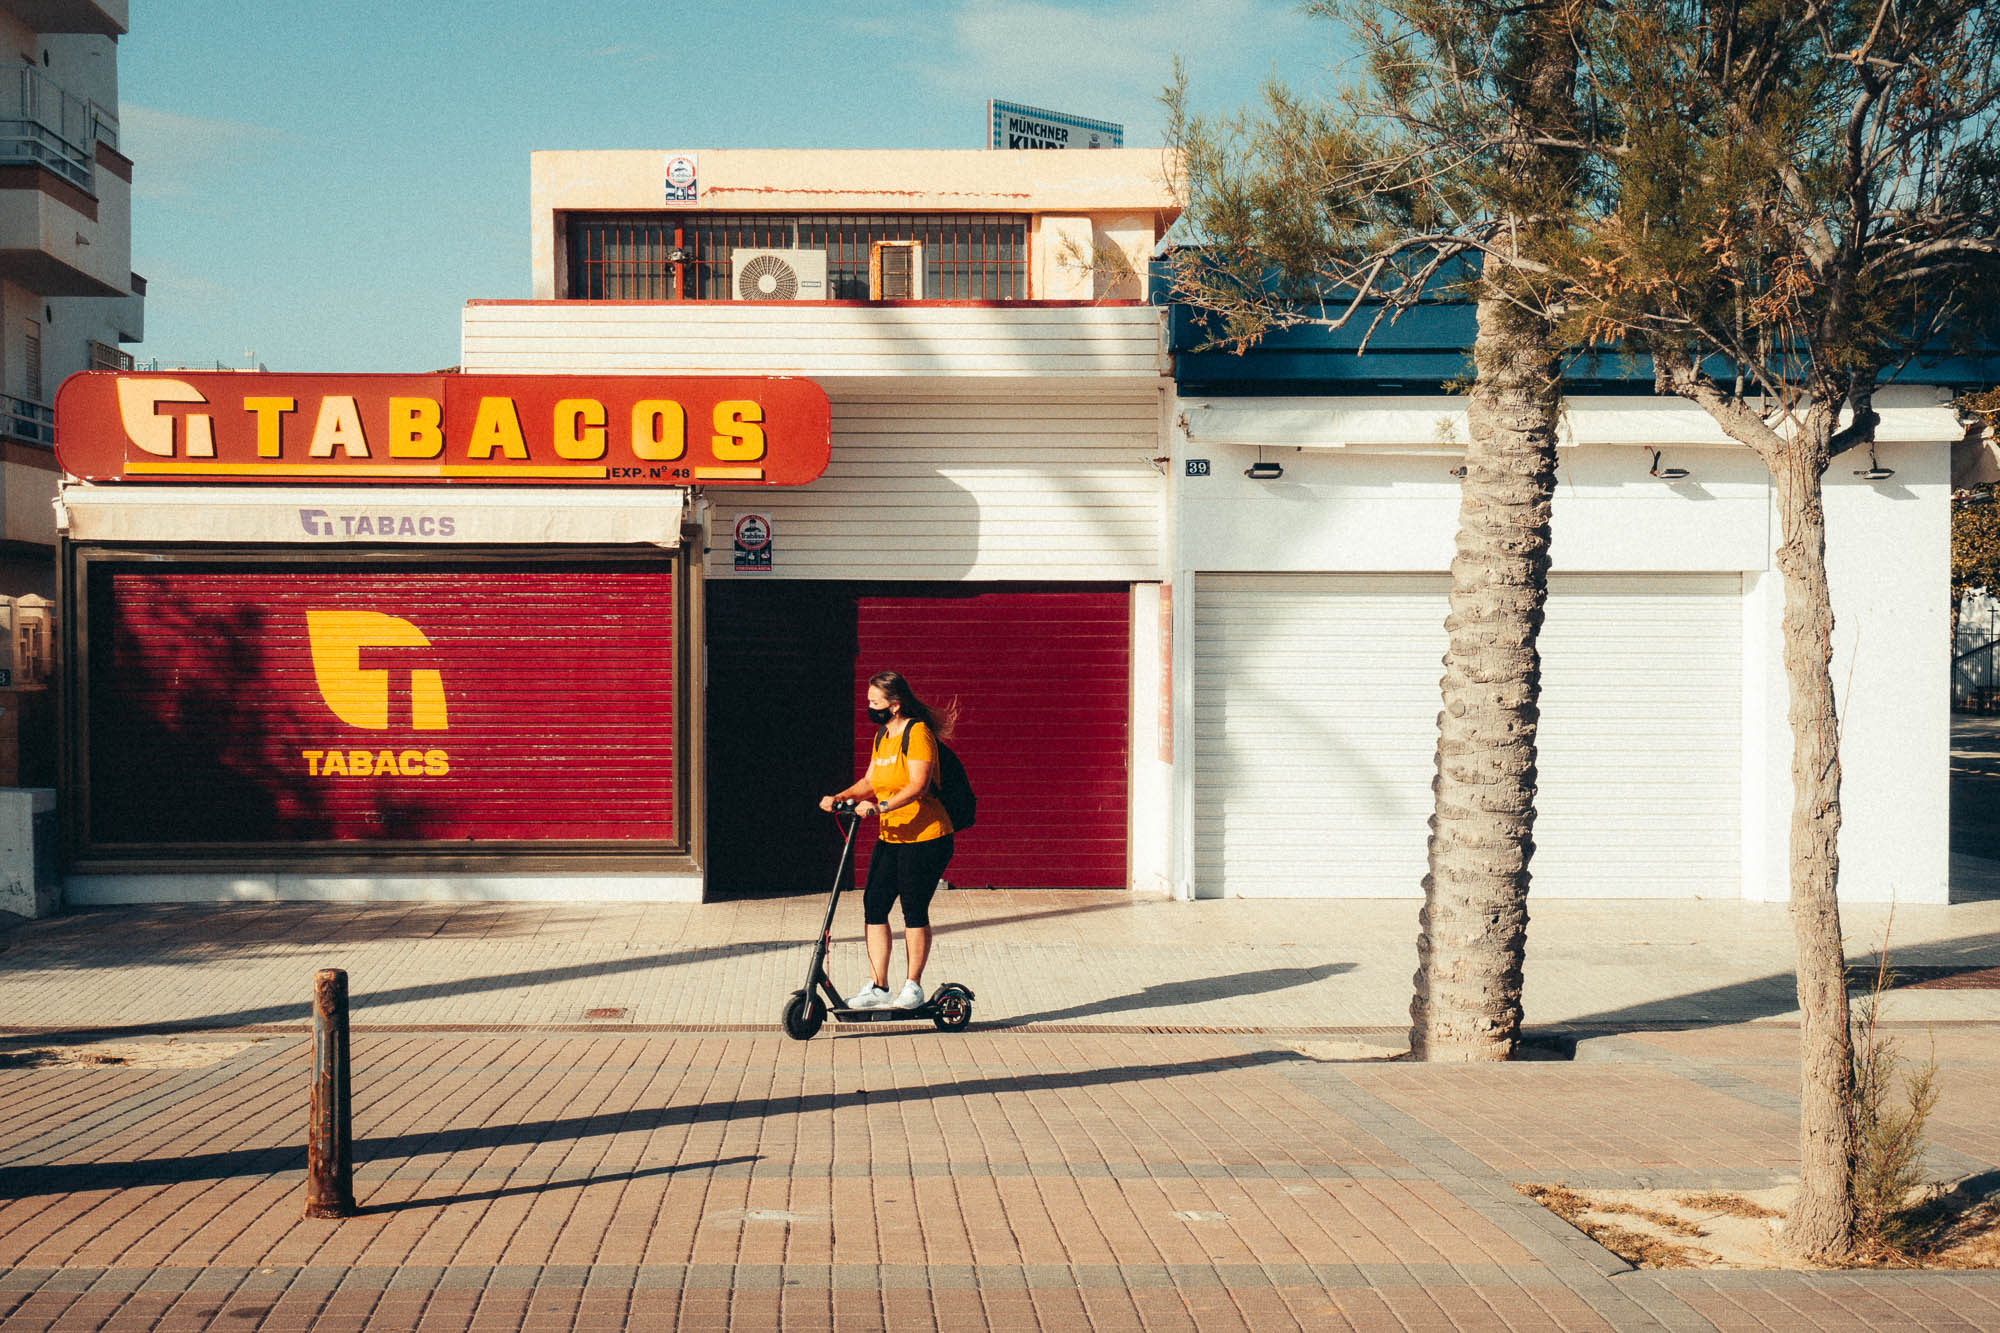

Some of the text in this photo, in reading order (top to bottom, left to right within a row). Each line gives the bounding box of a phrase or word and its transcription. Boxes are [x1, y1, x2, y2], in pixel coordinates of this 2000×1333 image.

[1009, 116, 1069, 143] MÜNCHNER
[243, 395, 766, 462] TABACOS
[611, 467, 646, 478] EXP.
[671, 468, 690, 478] 48
[1189, 462, 1207, 474] 39
[340, 516, 456, 537] TABACS
[302, 749, 450, 777] TABACS
